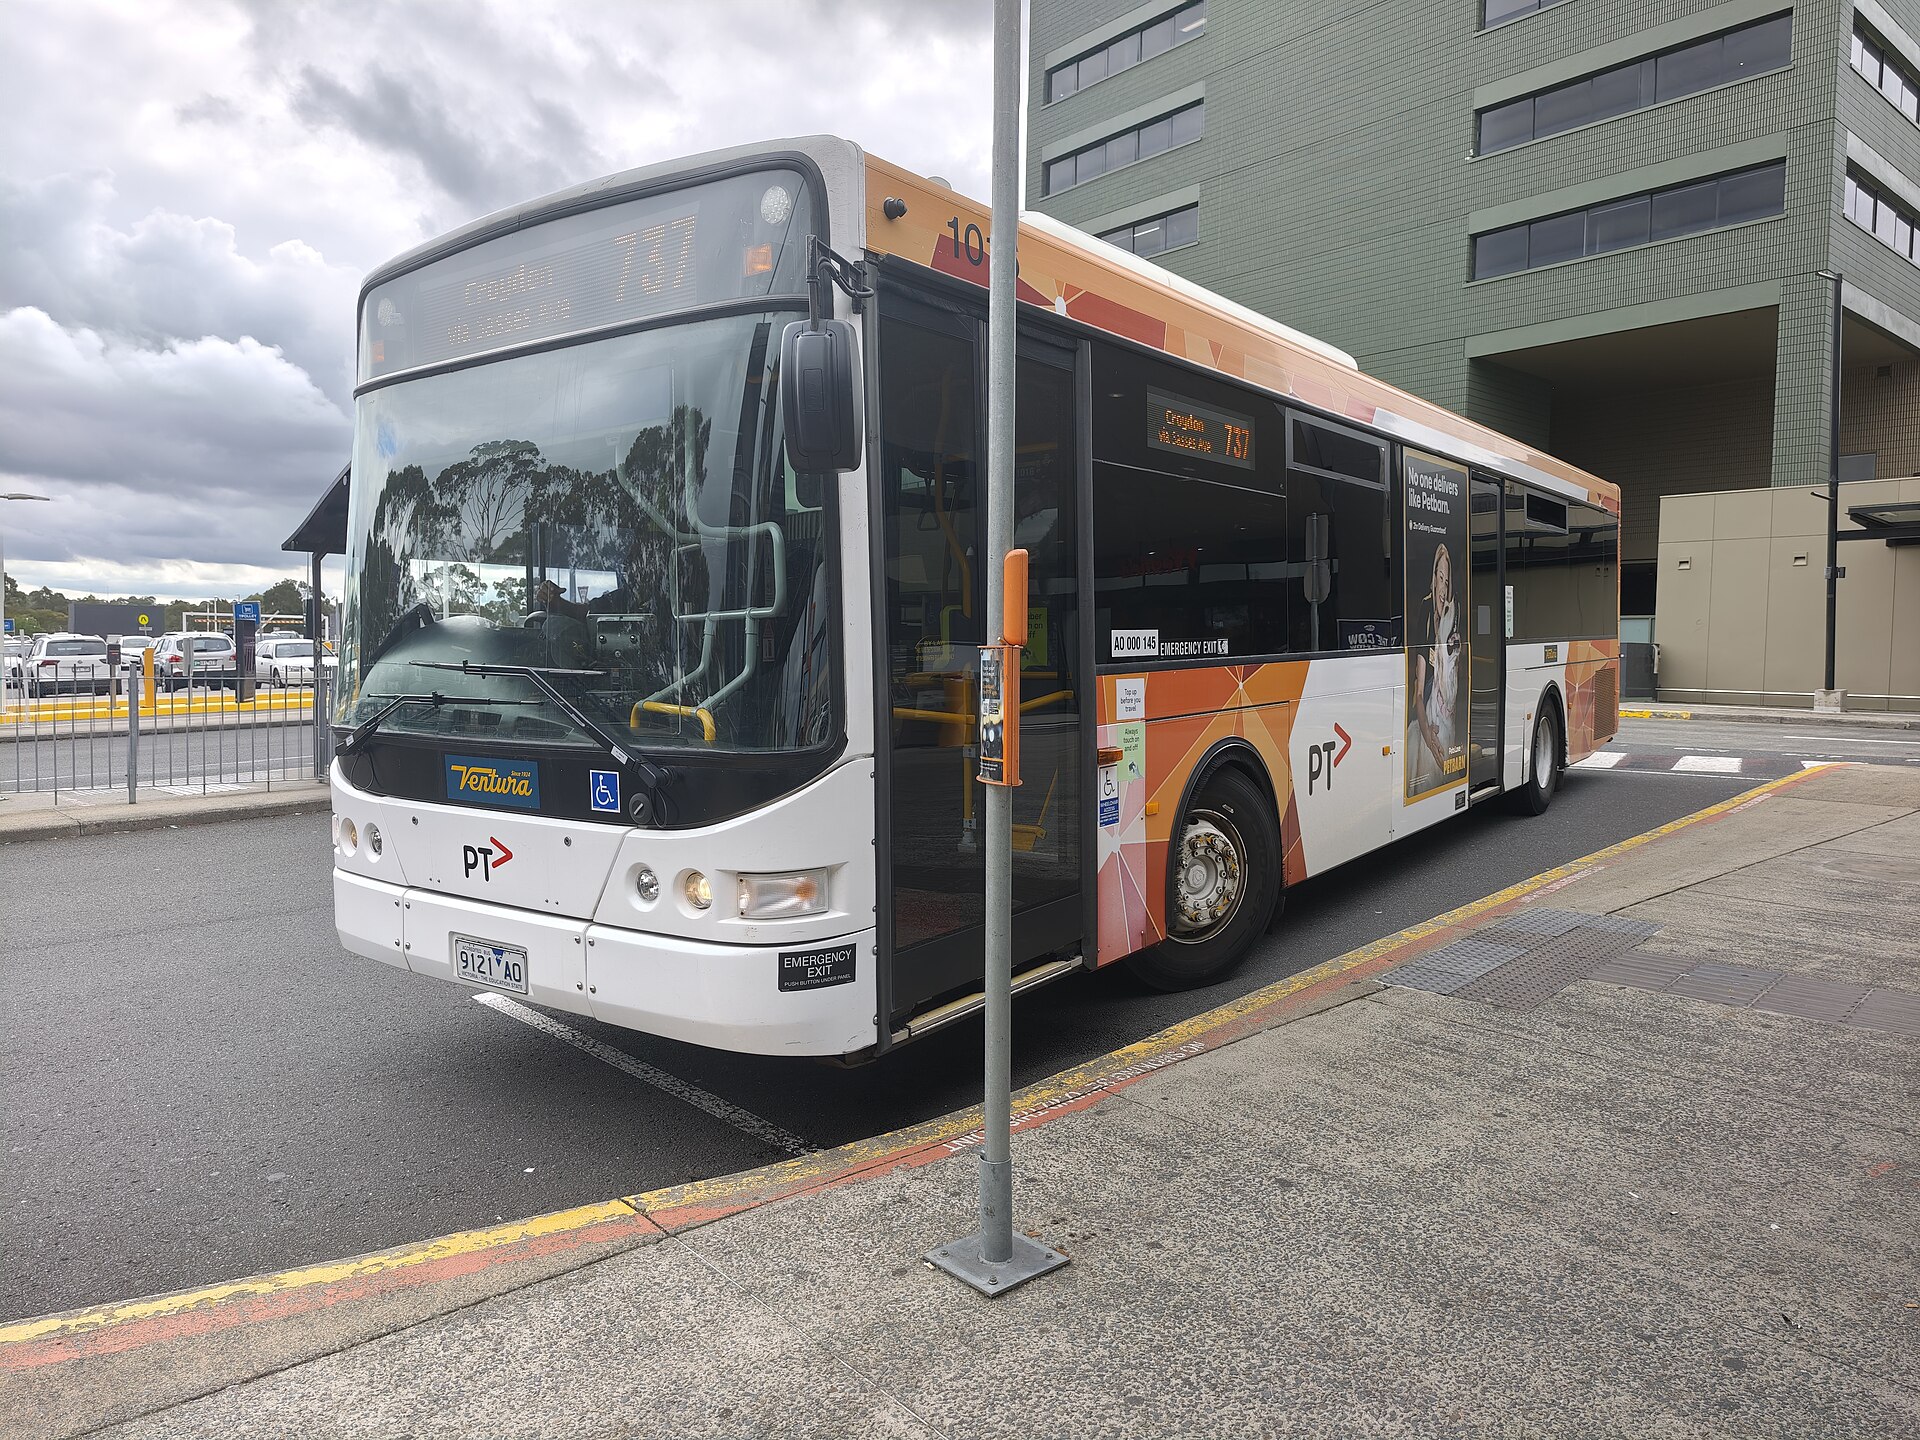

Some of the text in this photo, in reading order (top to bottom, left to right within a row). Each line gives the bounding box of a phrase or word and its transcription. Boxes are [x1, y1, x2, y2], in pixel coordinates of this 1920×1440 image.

[614, 215, 695, 302] 737
[465, 264, 553, 306] Croydon
[448, 317, 471, 345] via
[538, 298, 570, 326] Ave
[1164, 409, 1204, 432] Croydon
[1224, 423, 1249, 460] 737
[1408, 466, 1458, 496] No one delivers
[1408, 487, 1450, 514] like Petbarn.
[1126, 636, 1140, 650] 000
[1142, 636, 1156, 650] 145
[1160, 640, 1217, 656] EMERGENCY EXIT
[1120, 696, 1133, 704] before
[1124, 688, 1132, 696] Top
[1124, 728, 1139, 736] Always
[451, 765, 533, 797] Ventura
[460, 950, 492, 976] 9121
[784, 949, 852, 968] EMERGENCY
[461, 971, 478, 980] VICTORIA
[488, 977, 510, 988] EDUCATION
[807, 964, 833, 978] EXIT
[820, 975, 837, 983] UNDER
[837, 973, 851, 981] PANEL
